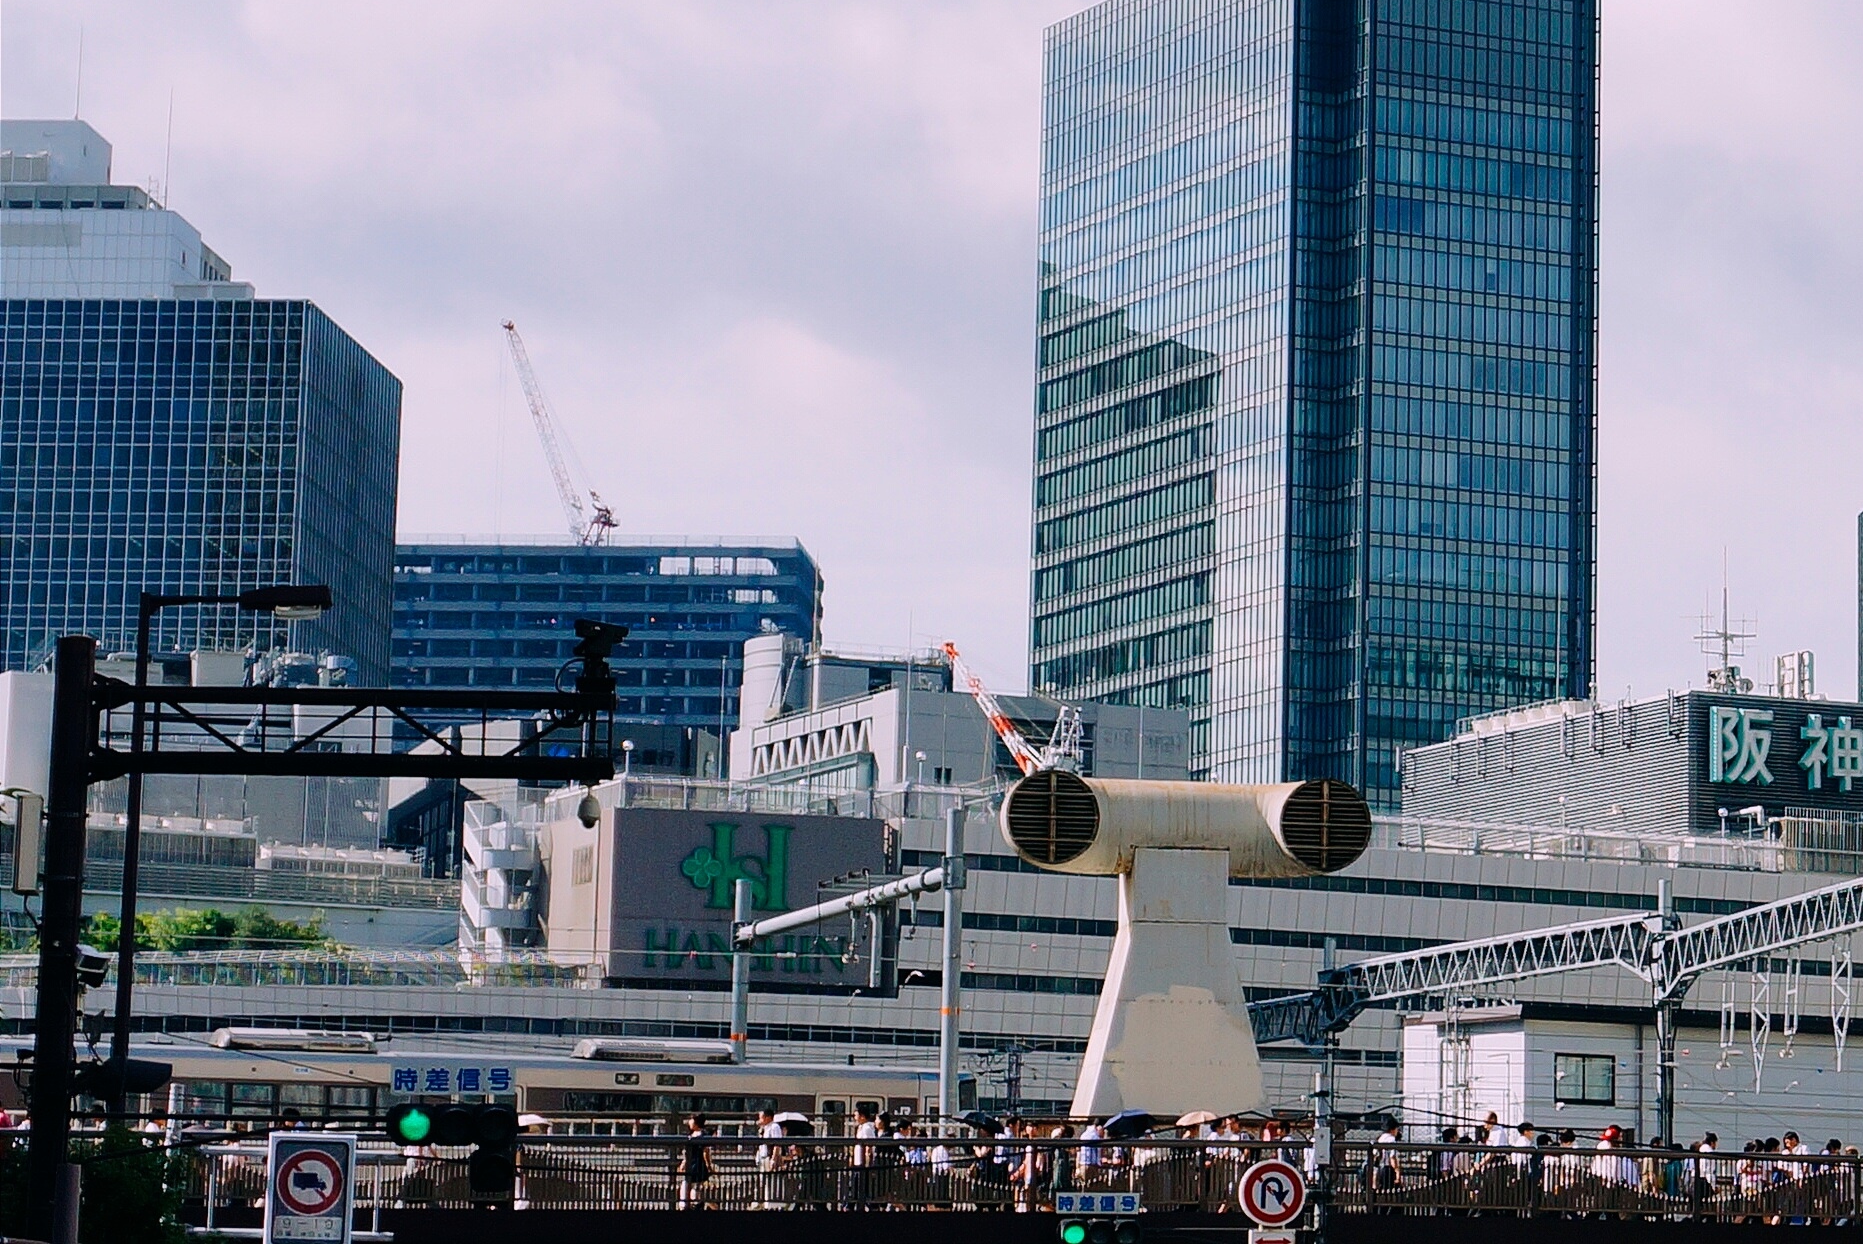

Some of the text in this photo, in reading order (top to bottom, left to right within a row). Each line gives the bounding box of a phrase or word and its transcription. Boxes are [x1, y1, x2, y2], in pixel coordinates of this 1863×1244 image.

[1709, 706, 1863, 792] 阪神
[643, 928, 846, 974] HANHIN
[394, 1067, 512, 1092] 時差信号
